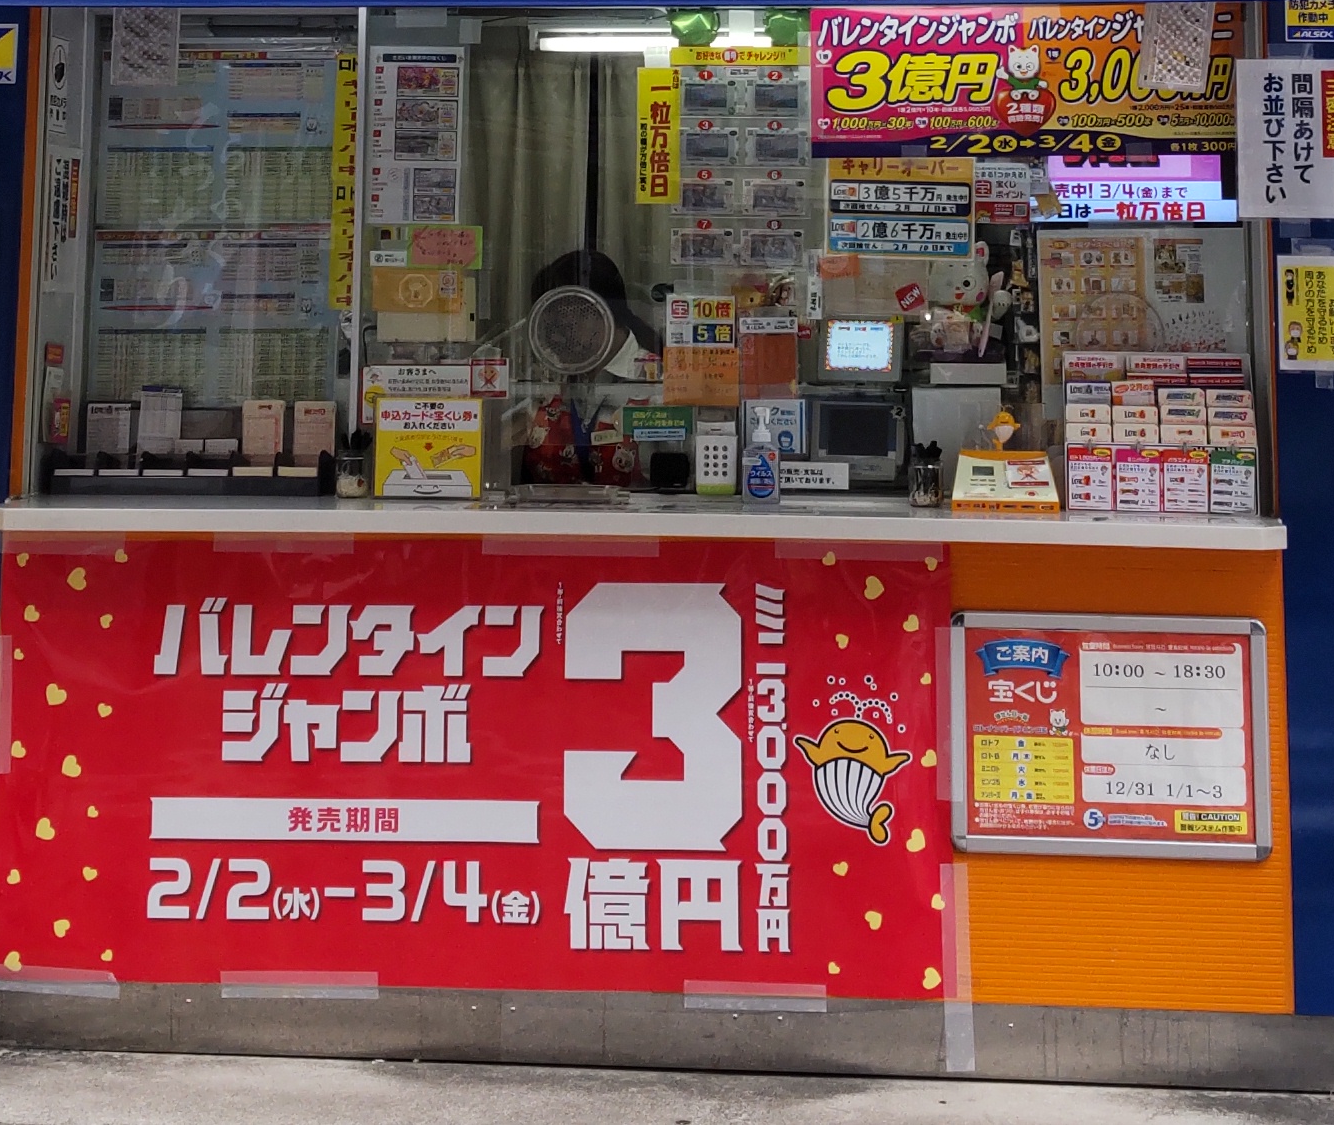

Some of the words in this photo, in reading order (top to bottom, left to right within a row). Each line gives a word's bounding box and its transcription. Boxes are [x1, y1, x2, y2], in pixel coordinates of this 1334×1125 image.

[1298, 12, 1329, 24] 作動中
[818, 13, 1018, 47] バレンタインジャンボ
[1300, 30, 1334, 38] ALSOK
[827, 49, 999, 113] 3億円
[1291, 73, 1315, 184] 間隔あけて
[650, 86, 671, 198] 一粒万倍日
[1170, 142, 1199, 152] 各1枚
[1263, 73, 1287, 204] お並び下さい
[842, 158, 959, 176] キャリーオーバー
[862, 186, 942, 202] 3億5千万円
[996, 191, 1026, 199] ポイント
[1100, 184, 1158, 199] 3/4(金)
[861, 222, 942, 240] 2億6千万円
[900, 286, 922, 309] NEW
[695, 302, 732, 318] 10倍
[1316, 270, 1328, 345] あなたを守るため
[696, 326, 732, 342] 5倍
[403, 422, 455, 430] お入れください
[153, 596, 544, 677] バレンタイン
[995, 646, 1050, 664] ご案内
[1093, 663, 1144, 678] 10:00
[1173, 664, 1226, 679] 18:30
[988, 679, 1057, 704] 宝くじ
[221, 683, 472, 764] ジャンボ
[1145, 744, 1176, 761] なし
[1105, 781, 1155, 797] 12/31
[287, 806, 401, 834] 発売期間
[1201, 813, 1240, 822] CAUTION
